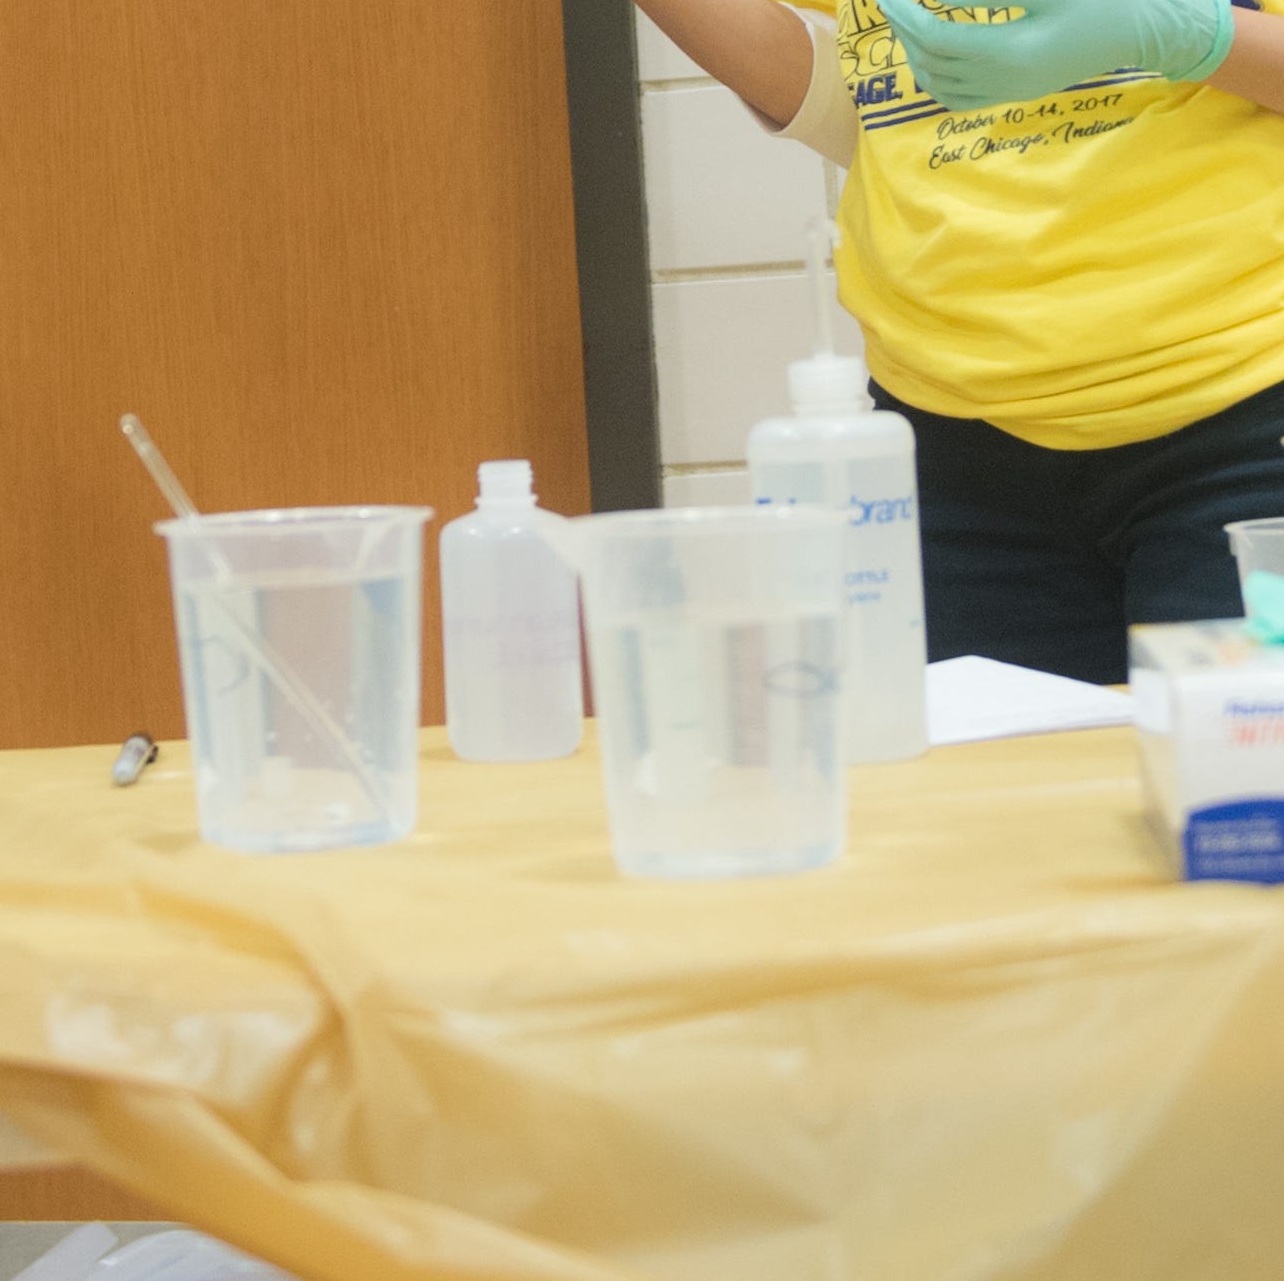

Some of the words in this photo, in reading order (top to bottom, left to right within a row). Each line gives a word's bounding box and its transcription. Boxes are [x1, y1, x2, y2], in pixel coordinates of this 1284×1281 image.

[928, 145, 966, 170] East
[968, 128, 1050, 162] Chicago,
[1052, 114, 1136, 145] Indiana
[936, 111, 998, 142] October
[1002, 102, 1064, 125] 10-14,
[1072, 93, 1124, 112] 2017
